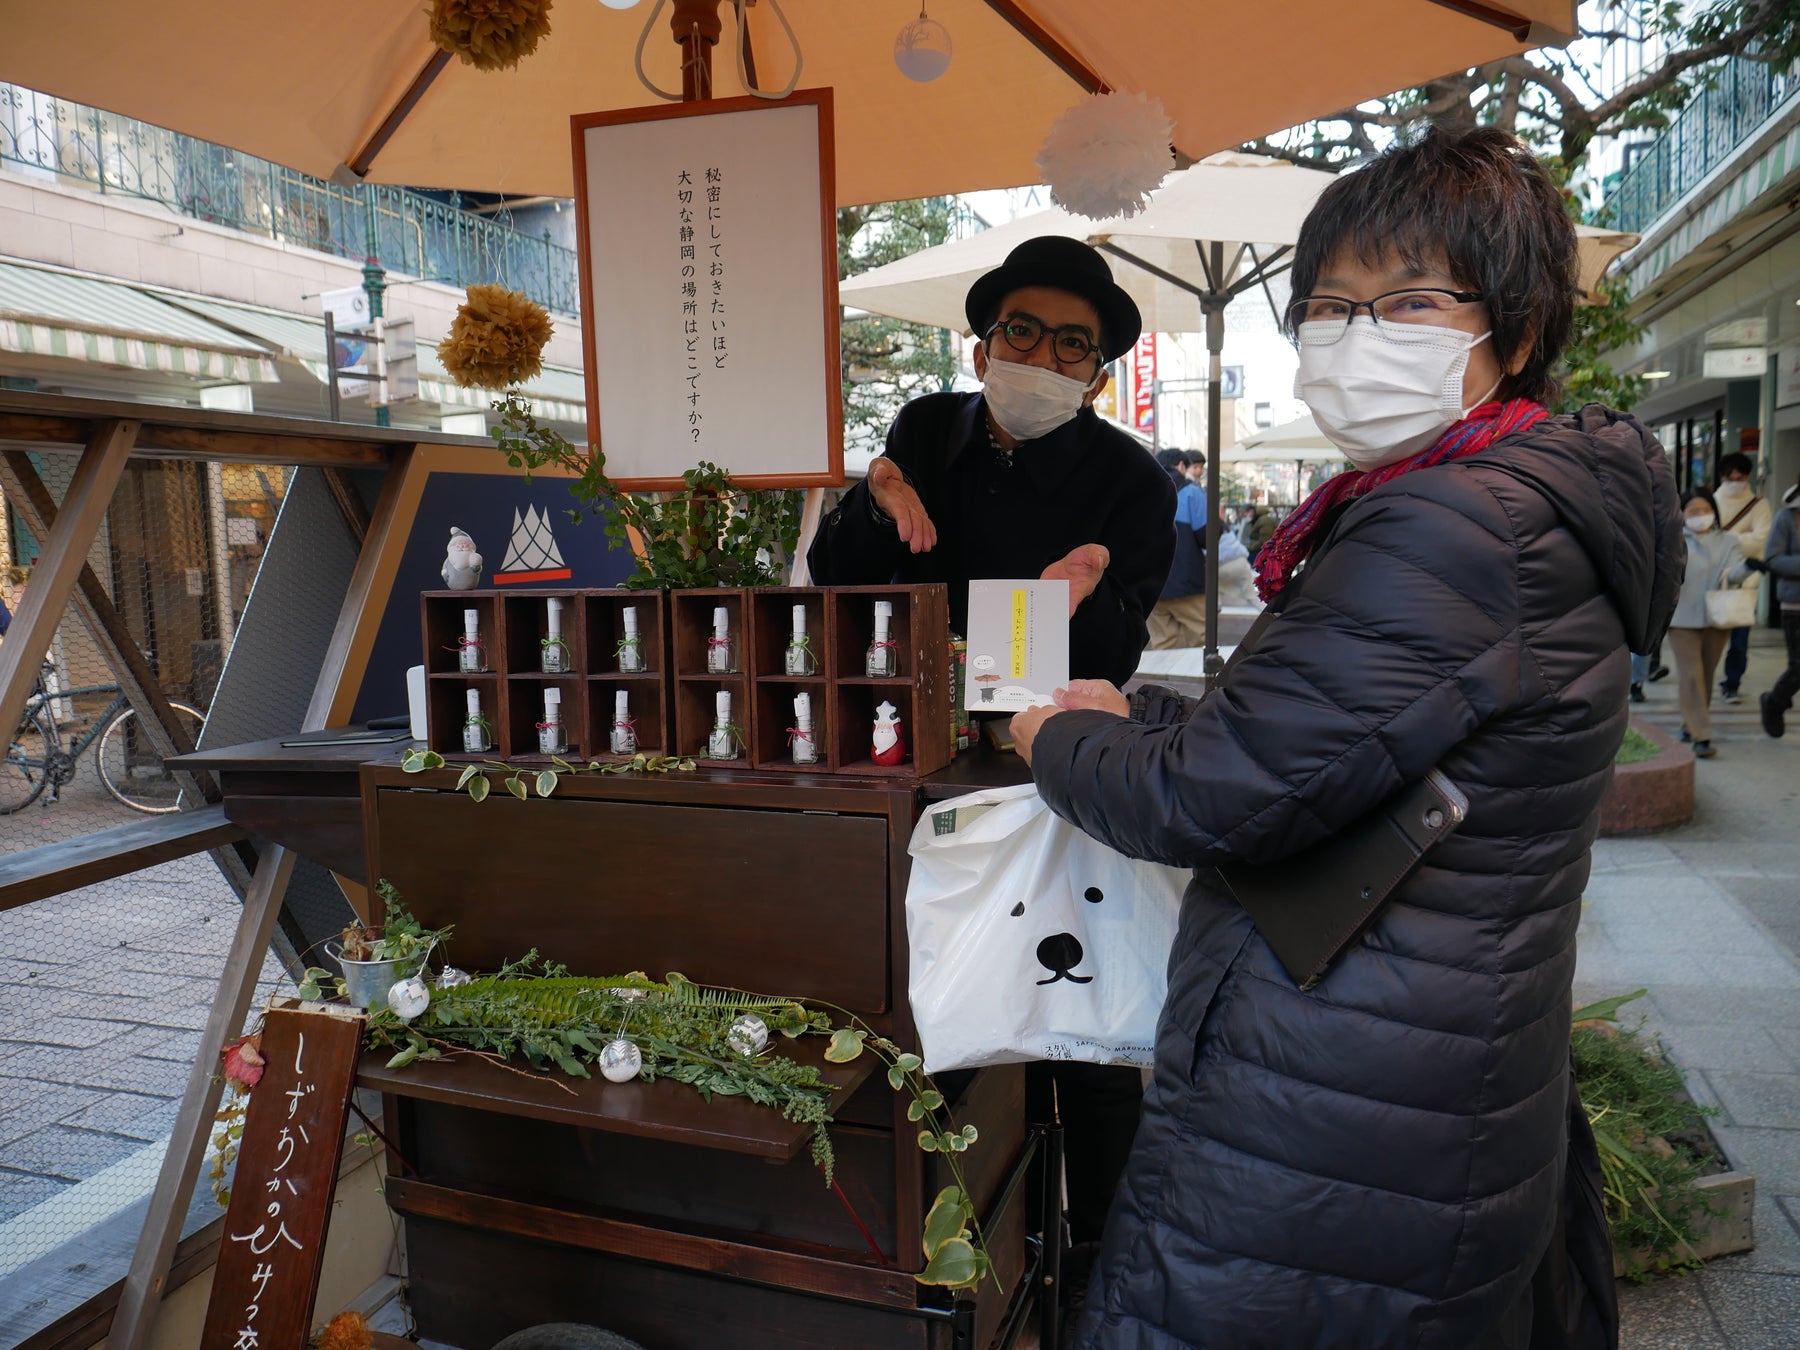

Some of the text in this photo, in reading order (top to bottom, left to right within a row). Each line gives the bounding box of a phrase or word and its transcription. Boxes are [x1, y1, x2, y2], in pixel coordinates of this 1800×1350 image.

[705, 167, 728, 370] 秘密にしておきたいほど
